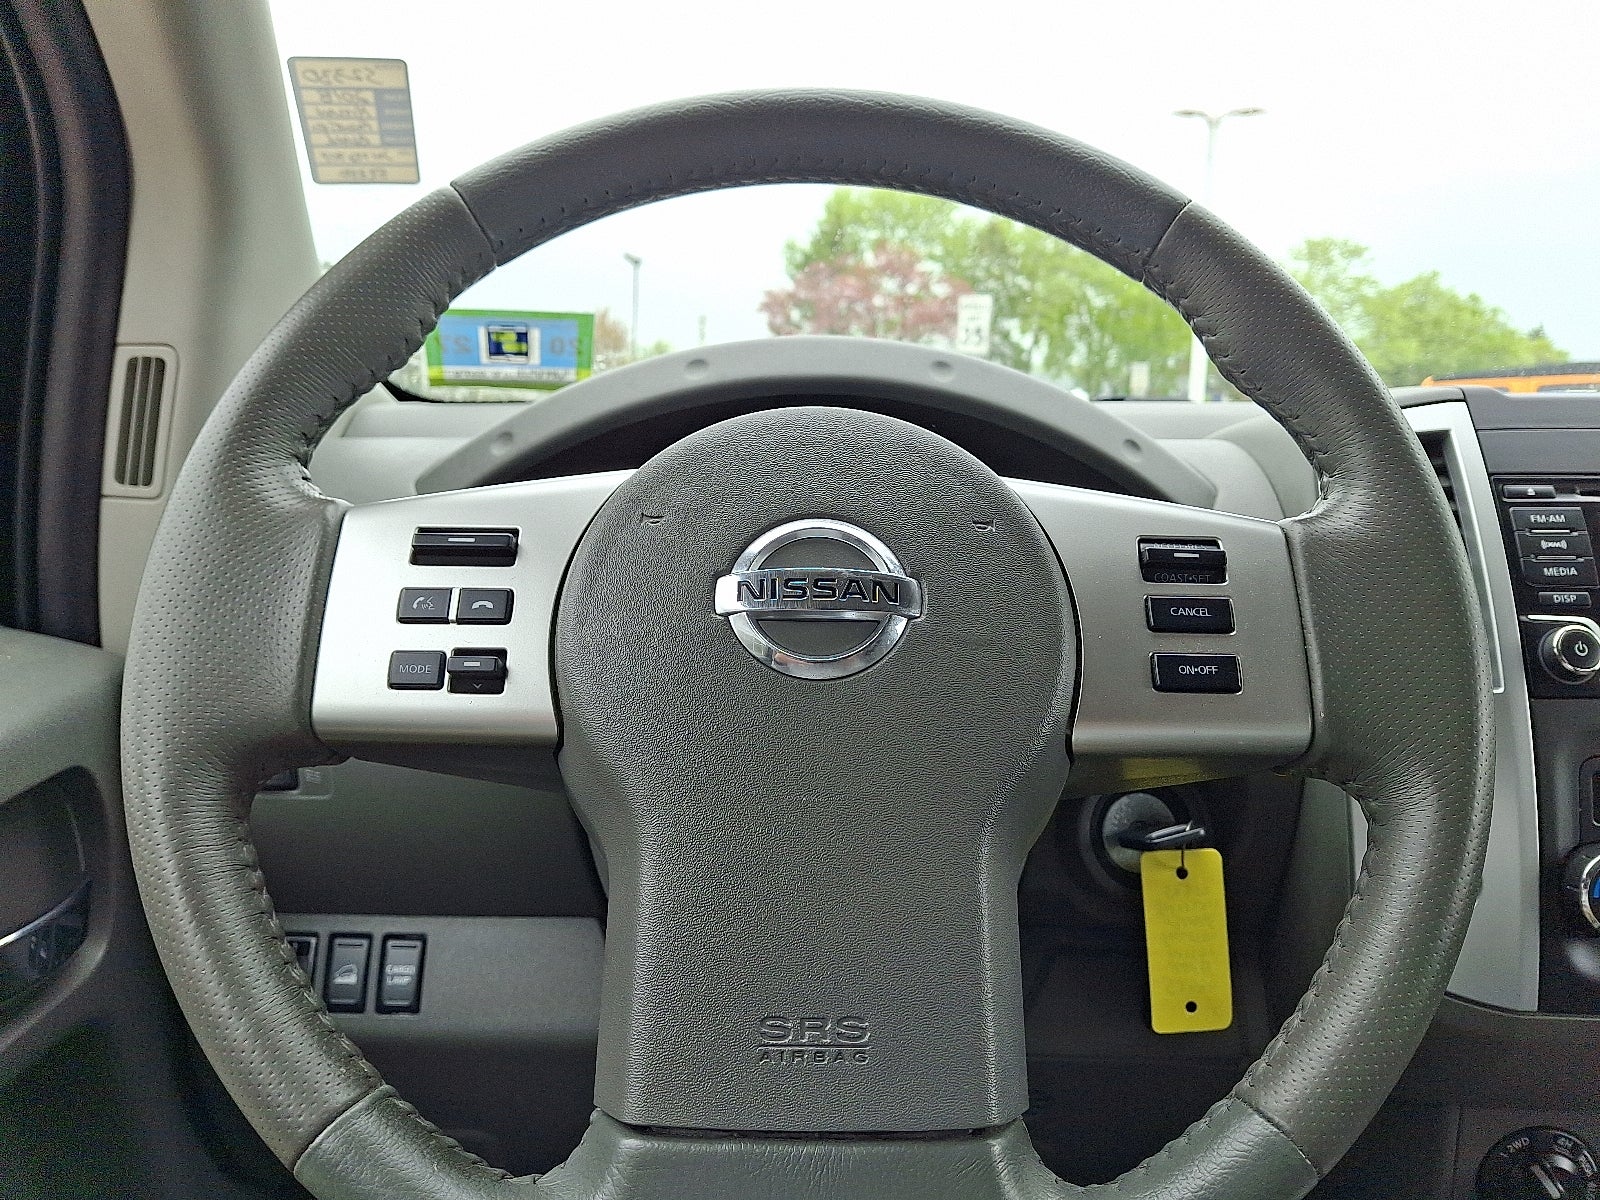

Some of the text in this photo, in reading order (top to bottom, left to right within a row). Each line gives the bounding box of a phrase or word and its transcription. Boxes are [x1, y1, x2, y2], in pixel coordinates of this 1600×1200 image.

[1543, 566, 1578, 576] MEDIA
[737, 577, 900, 606] NISSAN
[1553, 594, 1577, 603] DISP
[1170, 607, 1212, 617] CANCEL
[400, 664, 432, 674] MODE
[759, 1016, 870, 1044] SRS
[759, 1050, 870, 1065] AIRBAG
